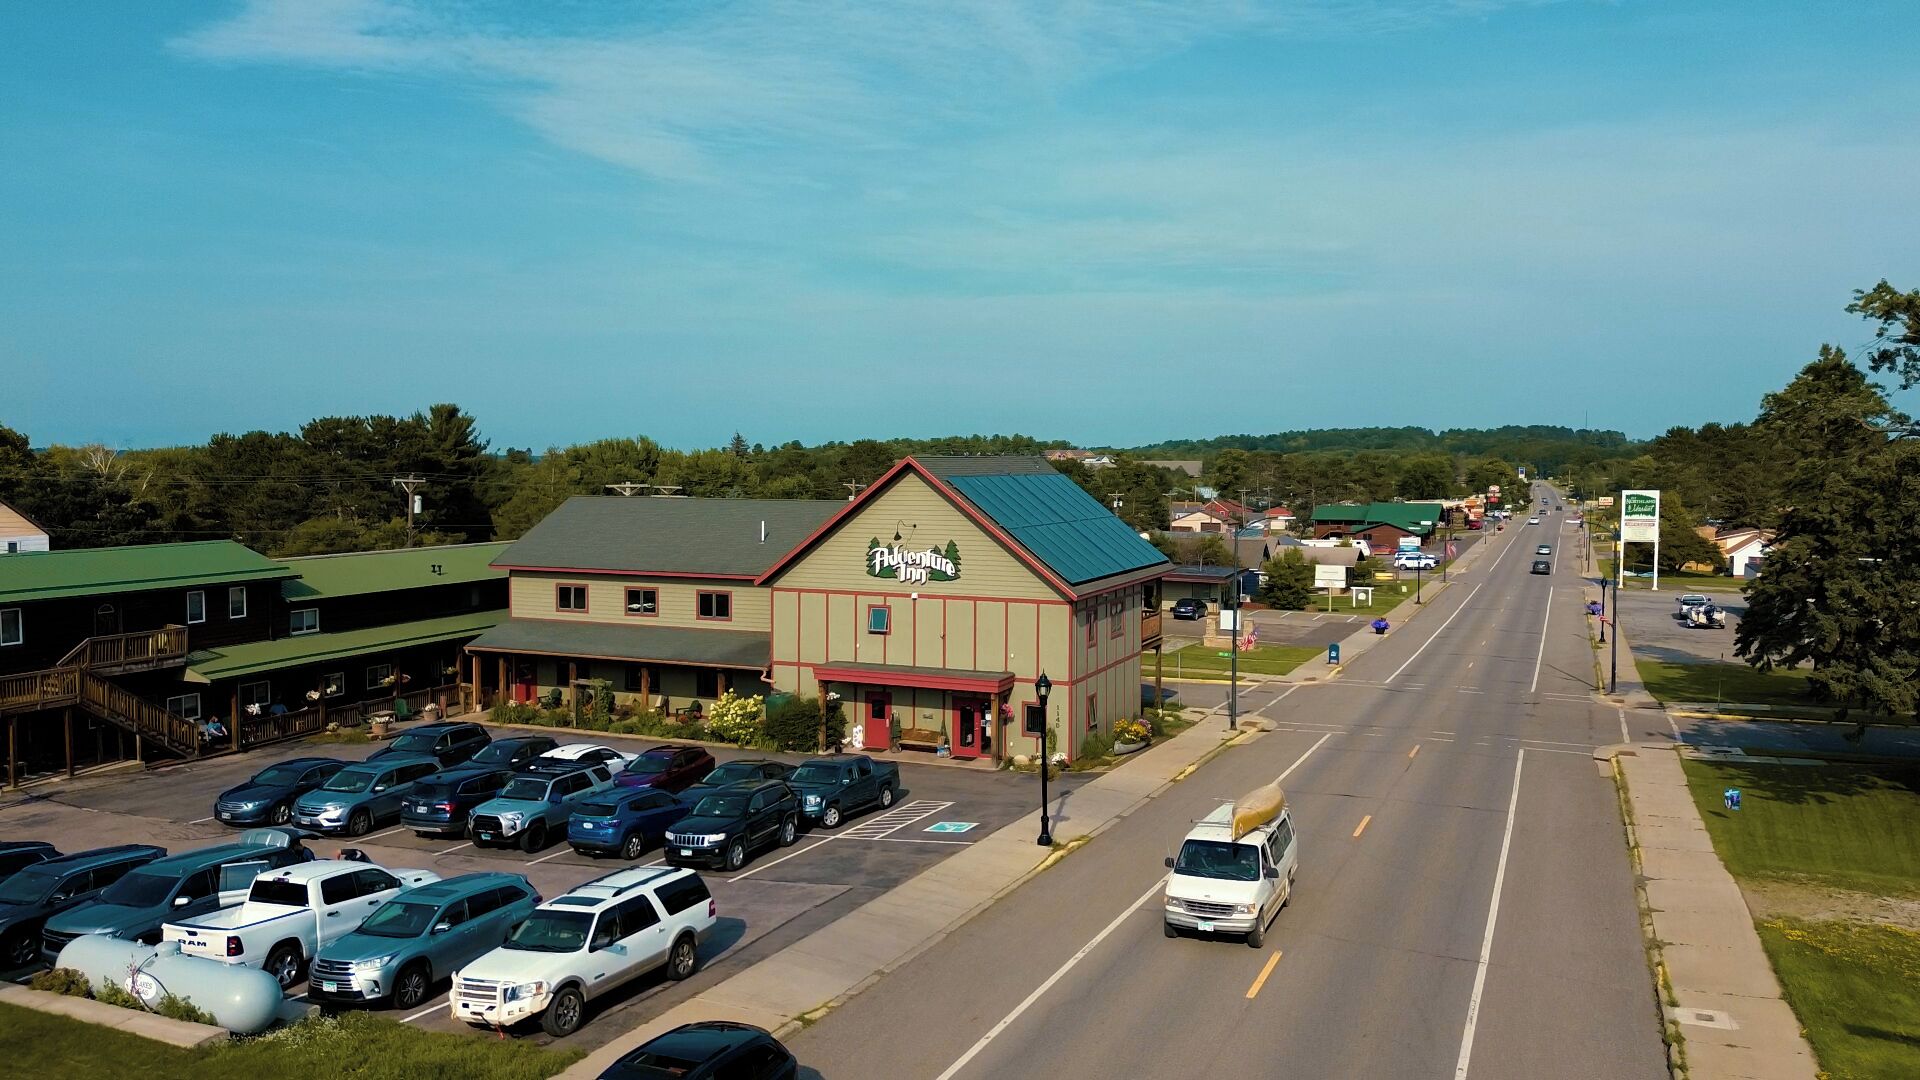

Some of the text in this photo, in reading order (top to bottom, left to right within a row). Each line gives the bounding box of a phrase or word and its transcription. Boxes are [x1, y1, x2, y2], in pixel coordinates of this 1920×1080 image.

[868, 544, 956, 577] Adventure
[893, 562, 927, 584] Inn
[178, 938, 207, 947] RAM
